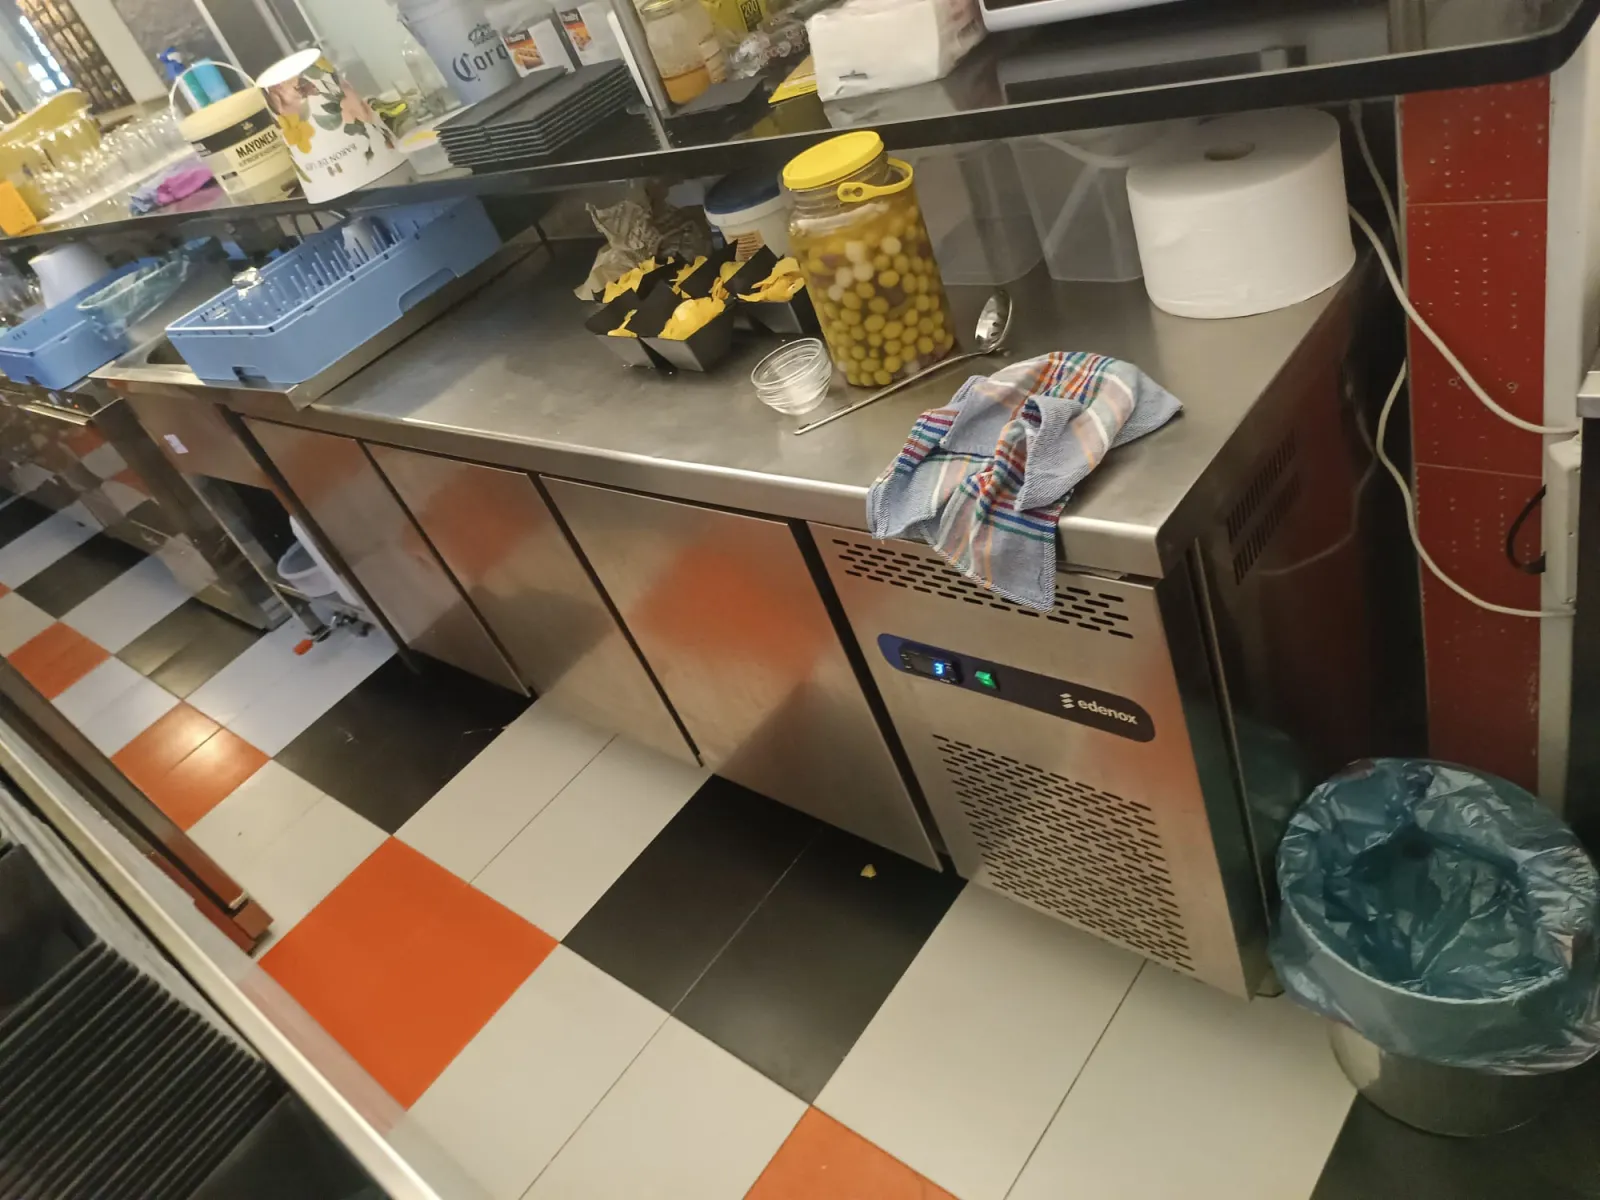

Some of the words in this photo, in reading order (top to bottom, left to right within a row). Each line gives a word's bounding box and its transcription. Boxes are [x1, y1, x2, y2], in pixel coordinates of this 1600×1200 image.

[235, 130, 278, 158] MAYONESA
[934, 662, 944, 675] 3
[1077, 699, 1138, 725] edenox
